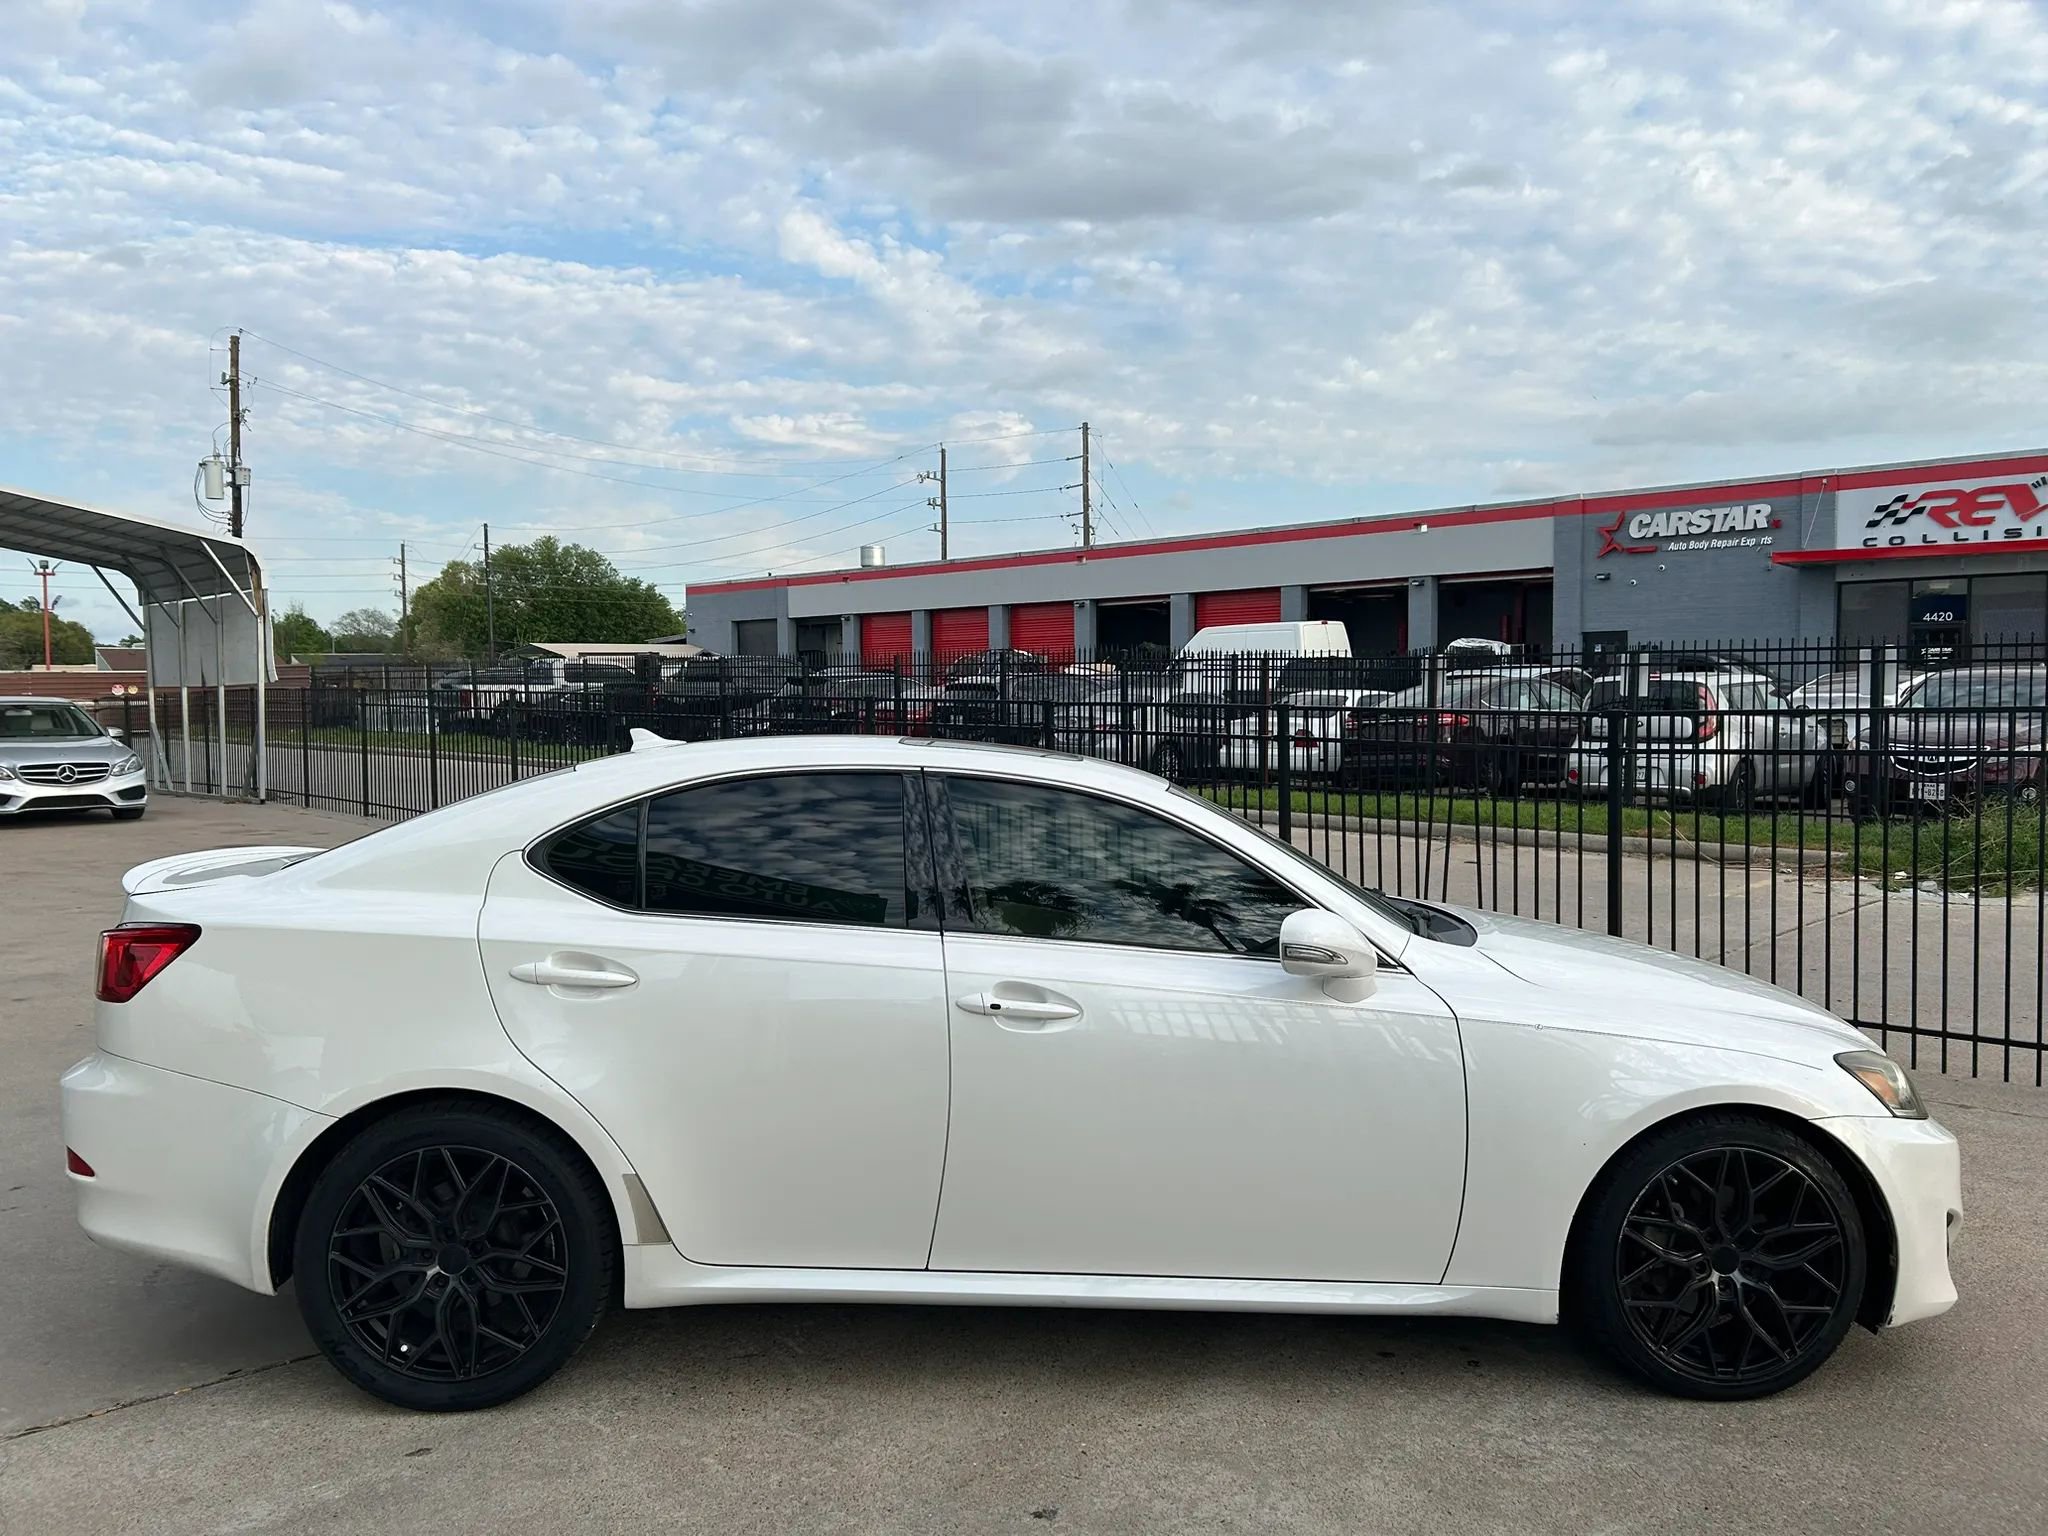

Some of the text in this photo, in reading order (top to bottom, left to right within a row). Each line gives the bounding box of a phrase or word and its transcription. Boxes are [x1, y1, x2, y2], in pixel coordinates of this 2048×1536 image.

[1628, 503, 1772, 539] CARSTAR
[1668, 541, 1687, 551] Auto
[1688, 540, 1708, 550] Body
[1711, 538, 1739, 549] Repair
[1922, 611, 1953, 622] 4420
